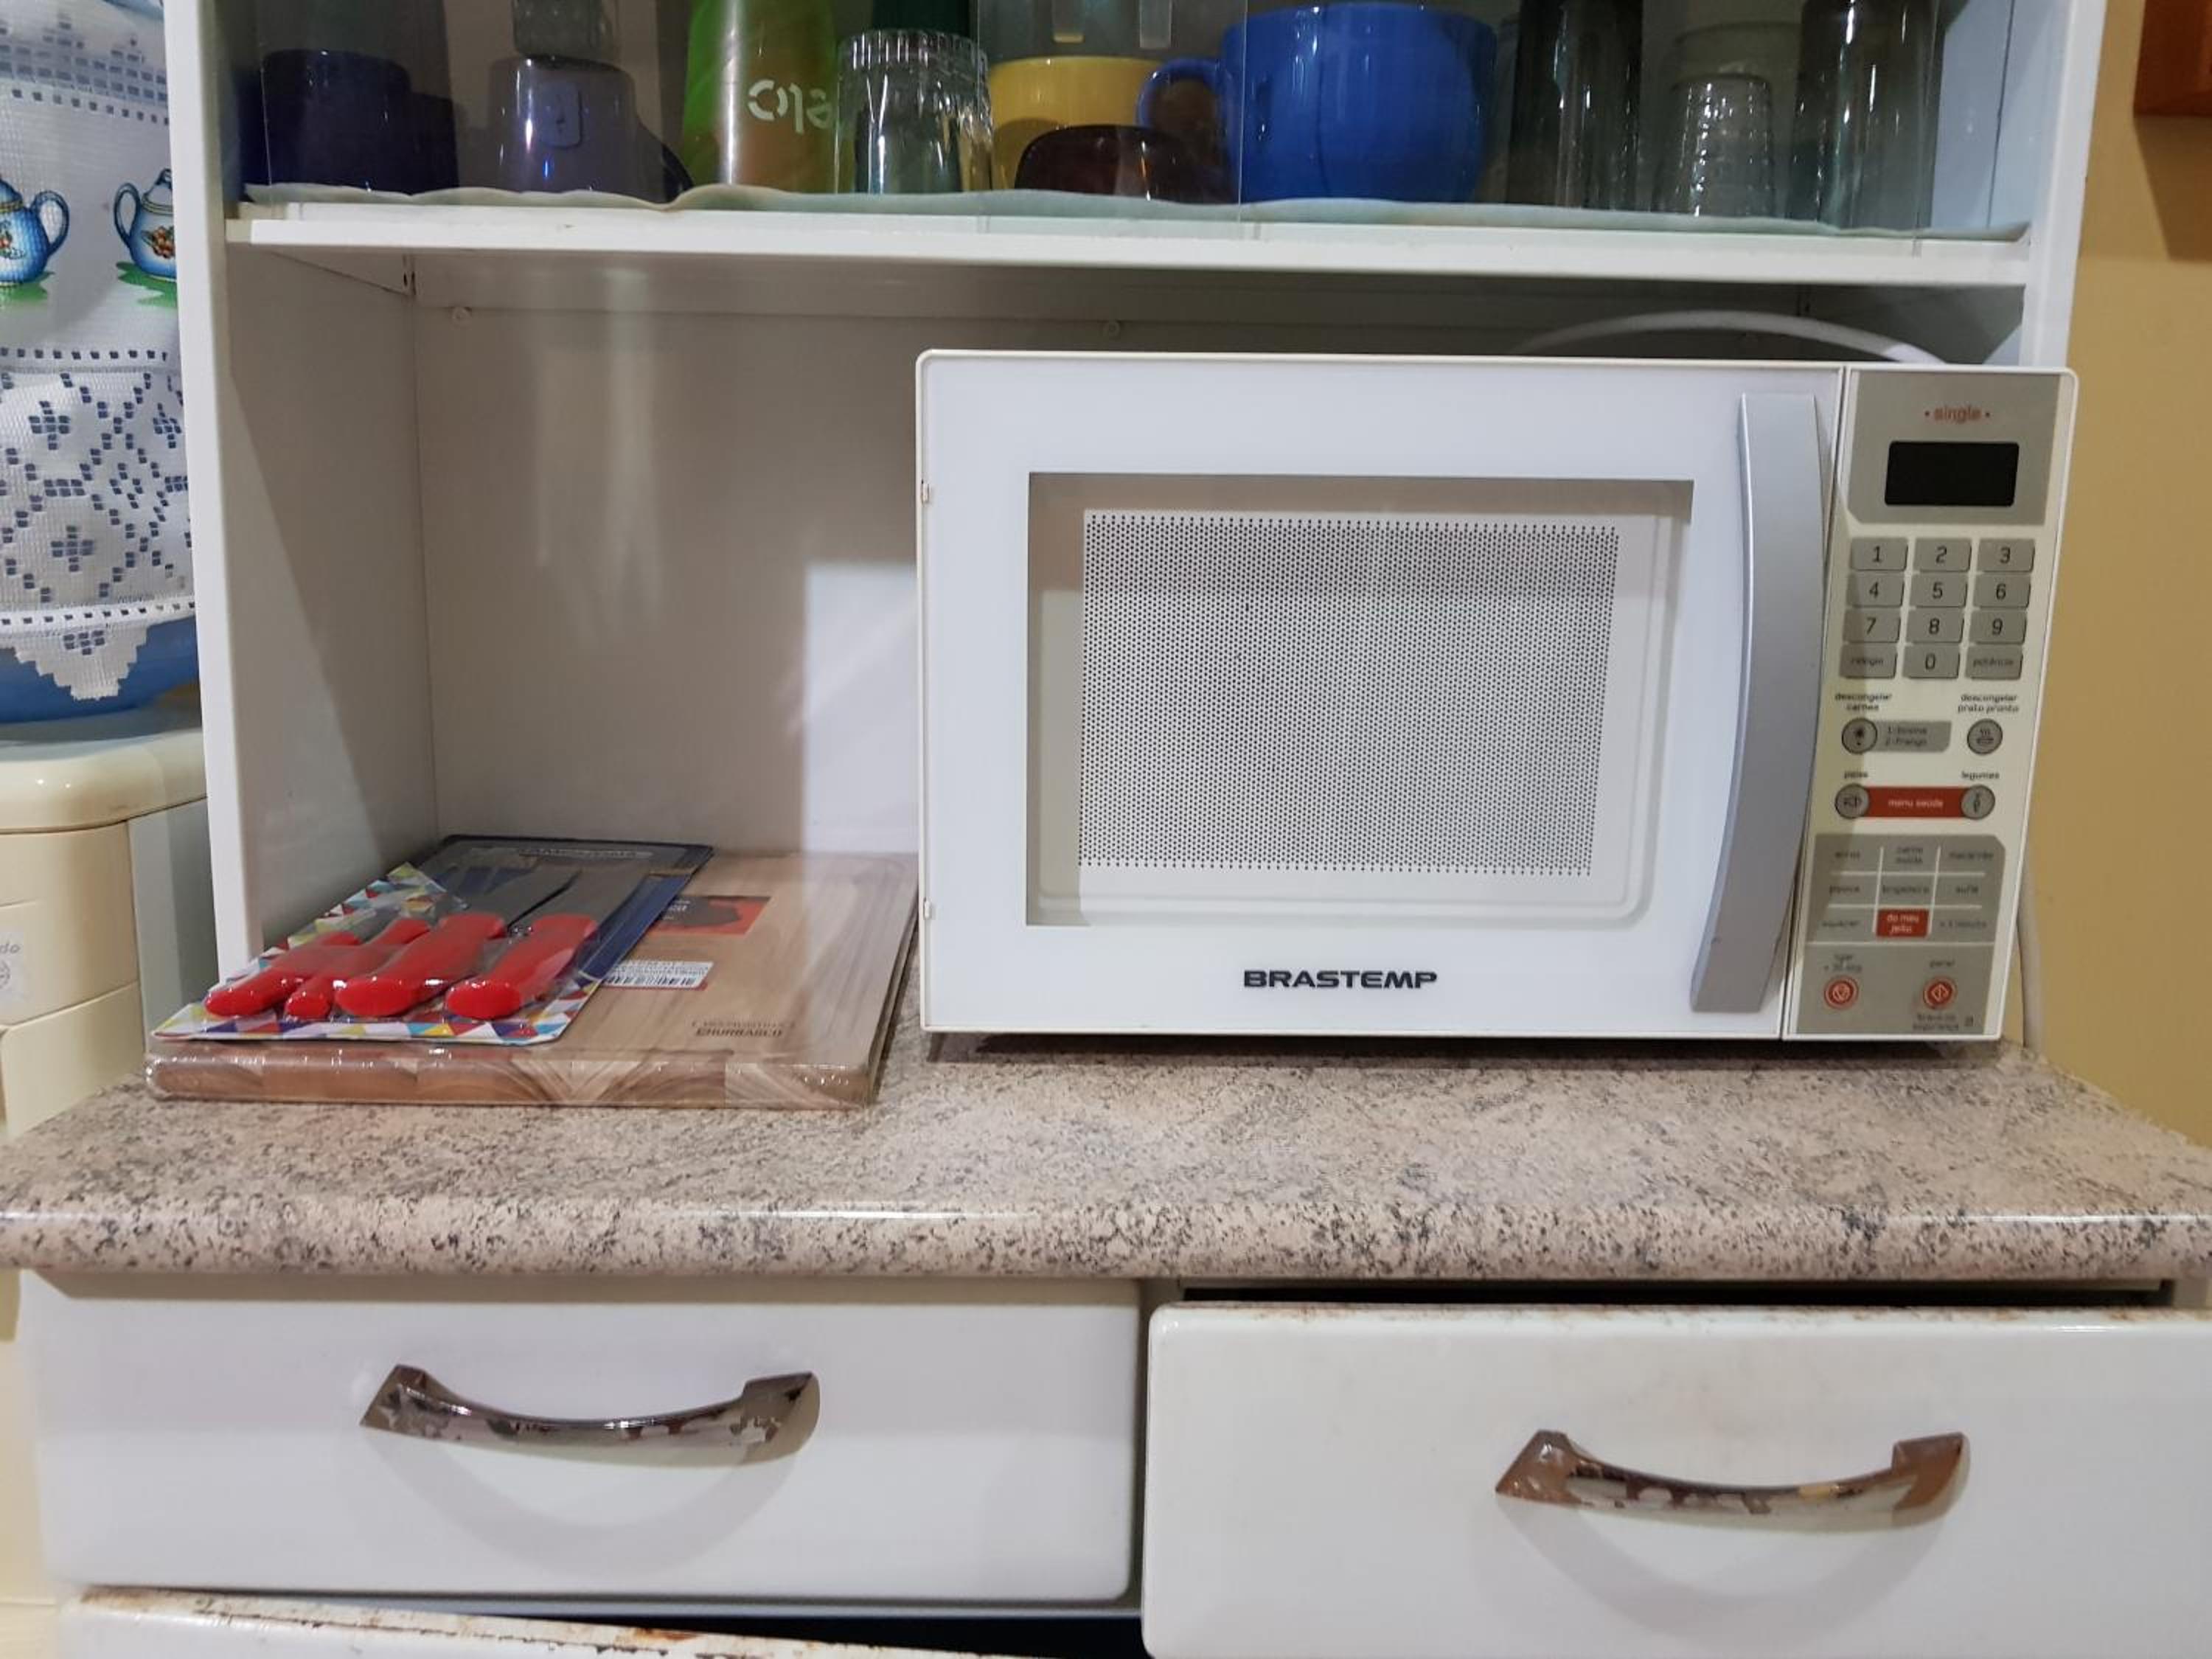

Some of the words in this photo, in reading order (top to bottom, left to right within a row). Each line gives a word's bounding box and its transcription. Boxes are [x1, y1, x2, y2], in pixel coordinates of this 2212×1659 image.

[1934, 404, 1981, 424] single
[1872, 545, 1882, 563] 1
[1935, 546, 1948, 564] 2
[2000, 547, 2011, 564] 3
[1869, 582, 1879, 598] 4
[1932, 582, 1944, 599] 5
[1995, 583, 2006, 600] 6
[1866, 617, 1877, 635] 7
[1929, 618, 1941, 635] 8
[1992, 619, 2004, 636] 9
[1924, 653, 1936, 670] 0
[1961, 694, 2017, 703] descongelar
[1244, 970, 1437, 989] BRASTEMP
